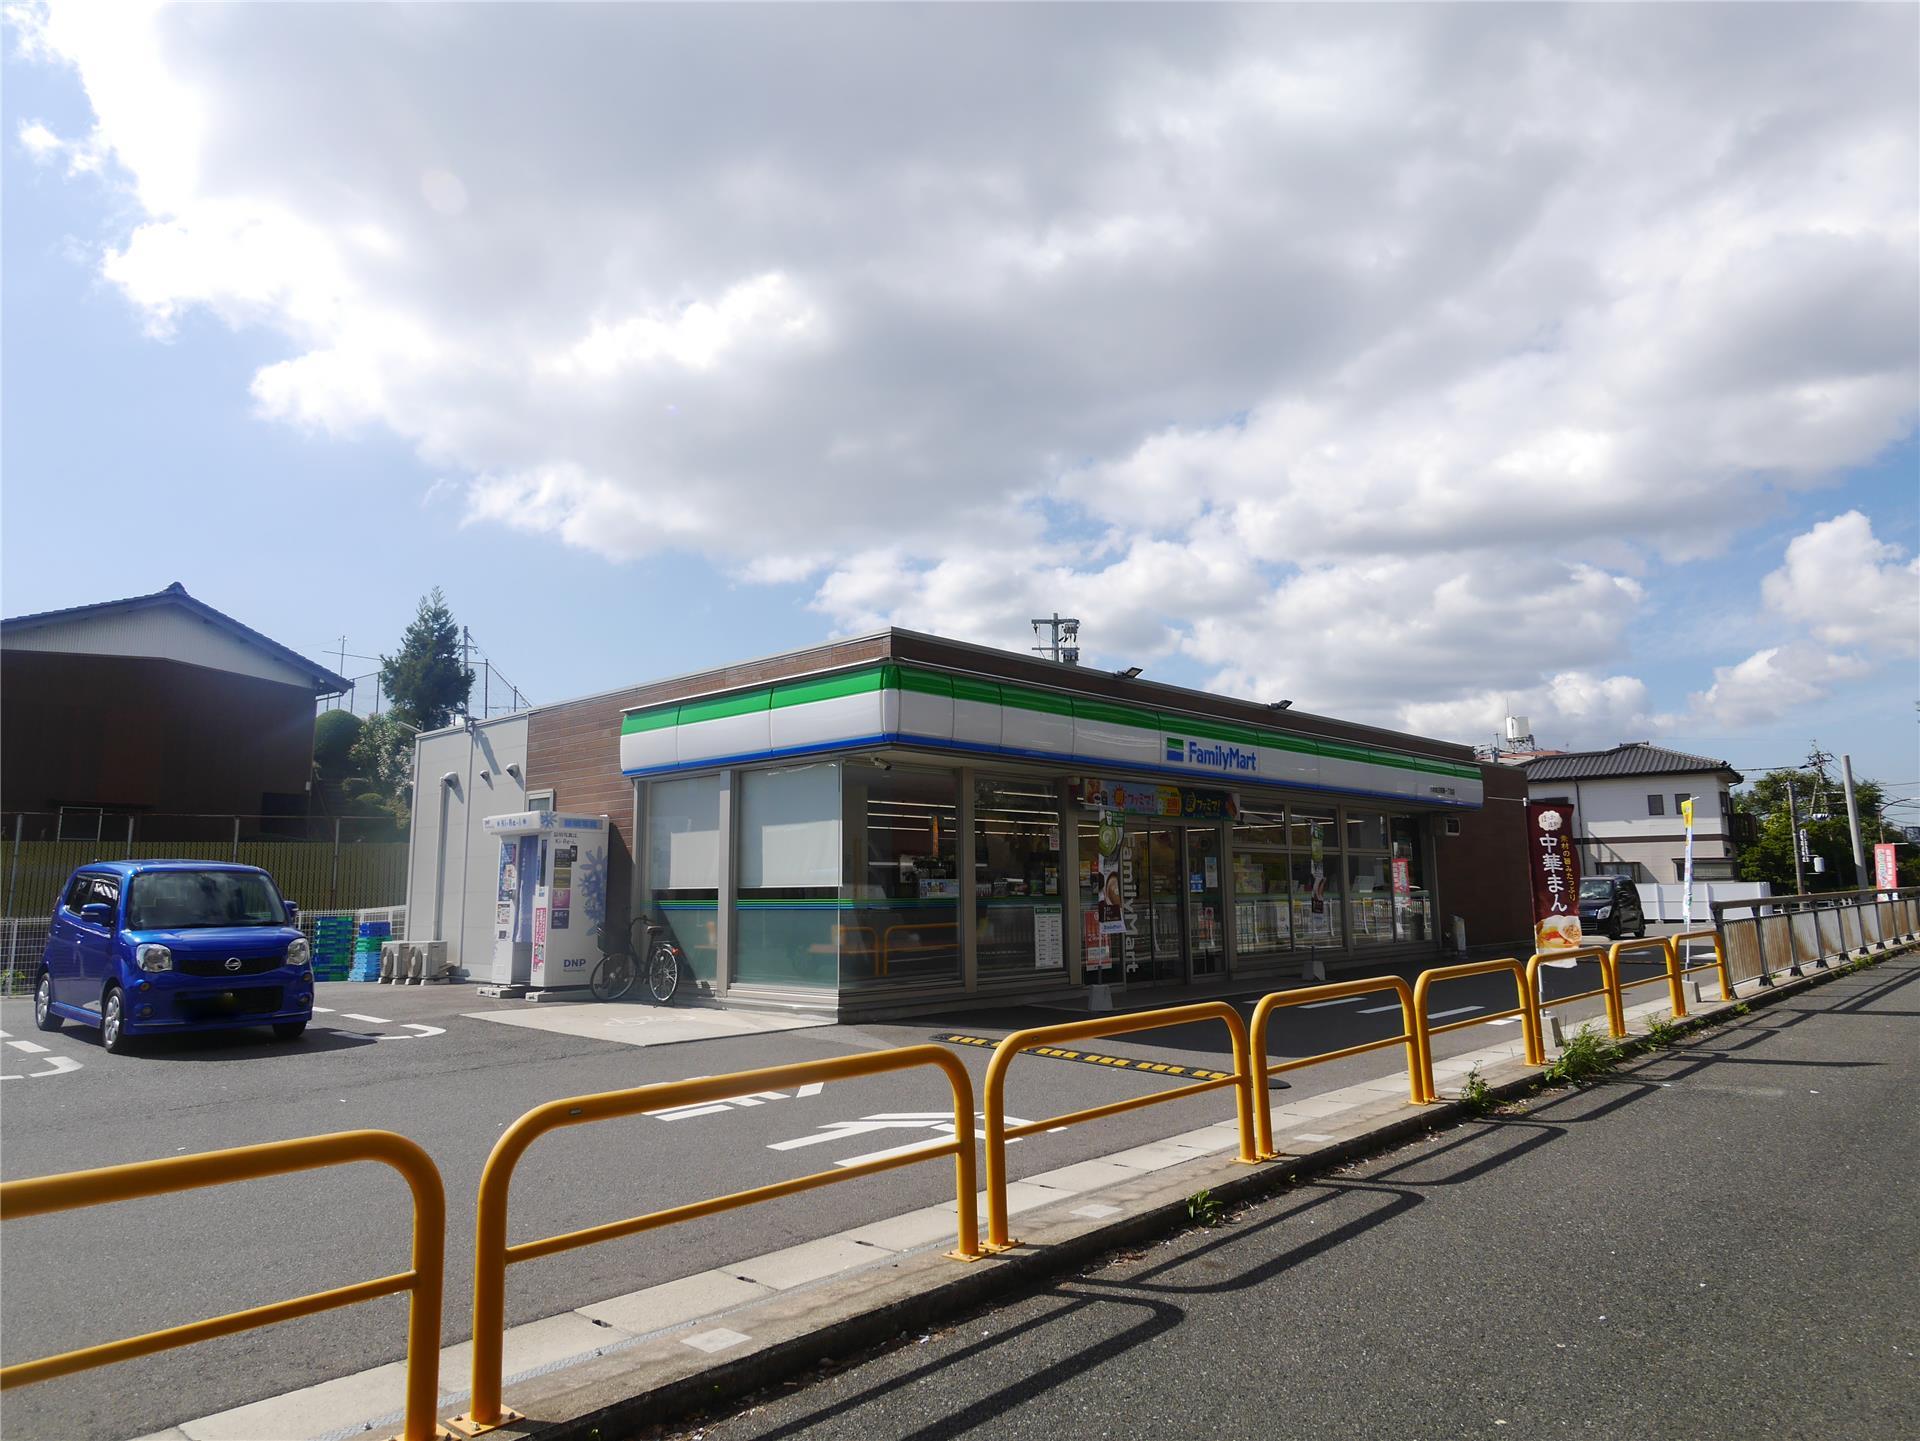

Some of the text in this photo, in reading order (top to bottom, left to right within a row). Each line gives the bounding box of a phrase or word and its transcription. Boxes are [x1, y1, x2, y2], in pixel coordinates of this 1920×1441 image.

[1189, 741, 1256, 770] FamilyMart
[1539, 833, 1568, 912] 中華まん
[1122, 835, 1140, 974] FamilyMart
[563, 959, 587, 968] DNP
